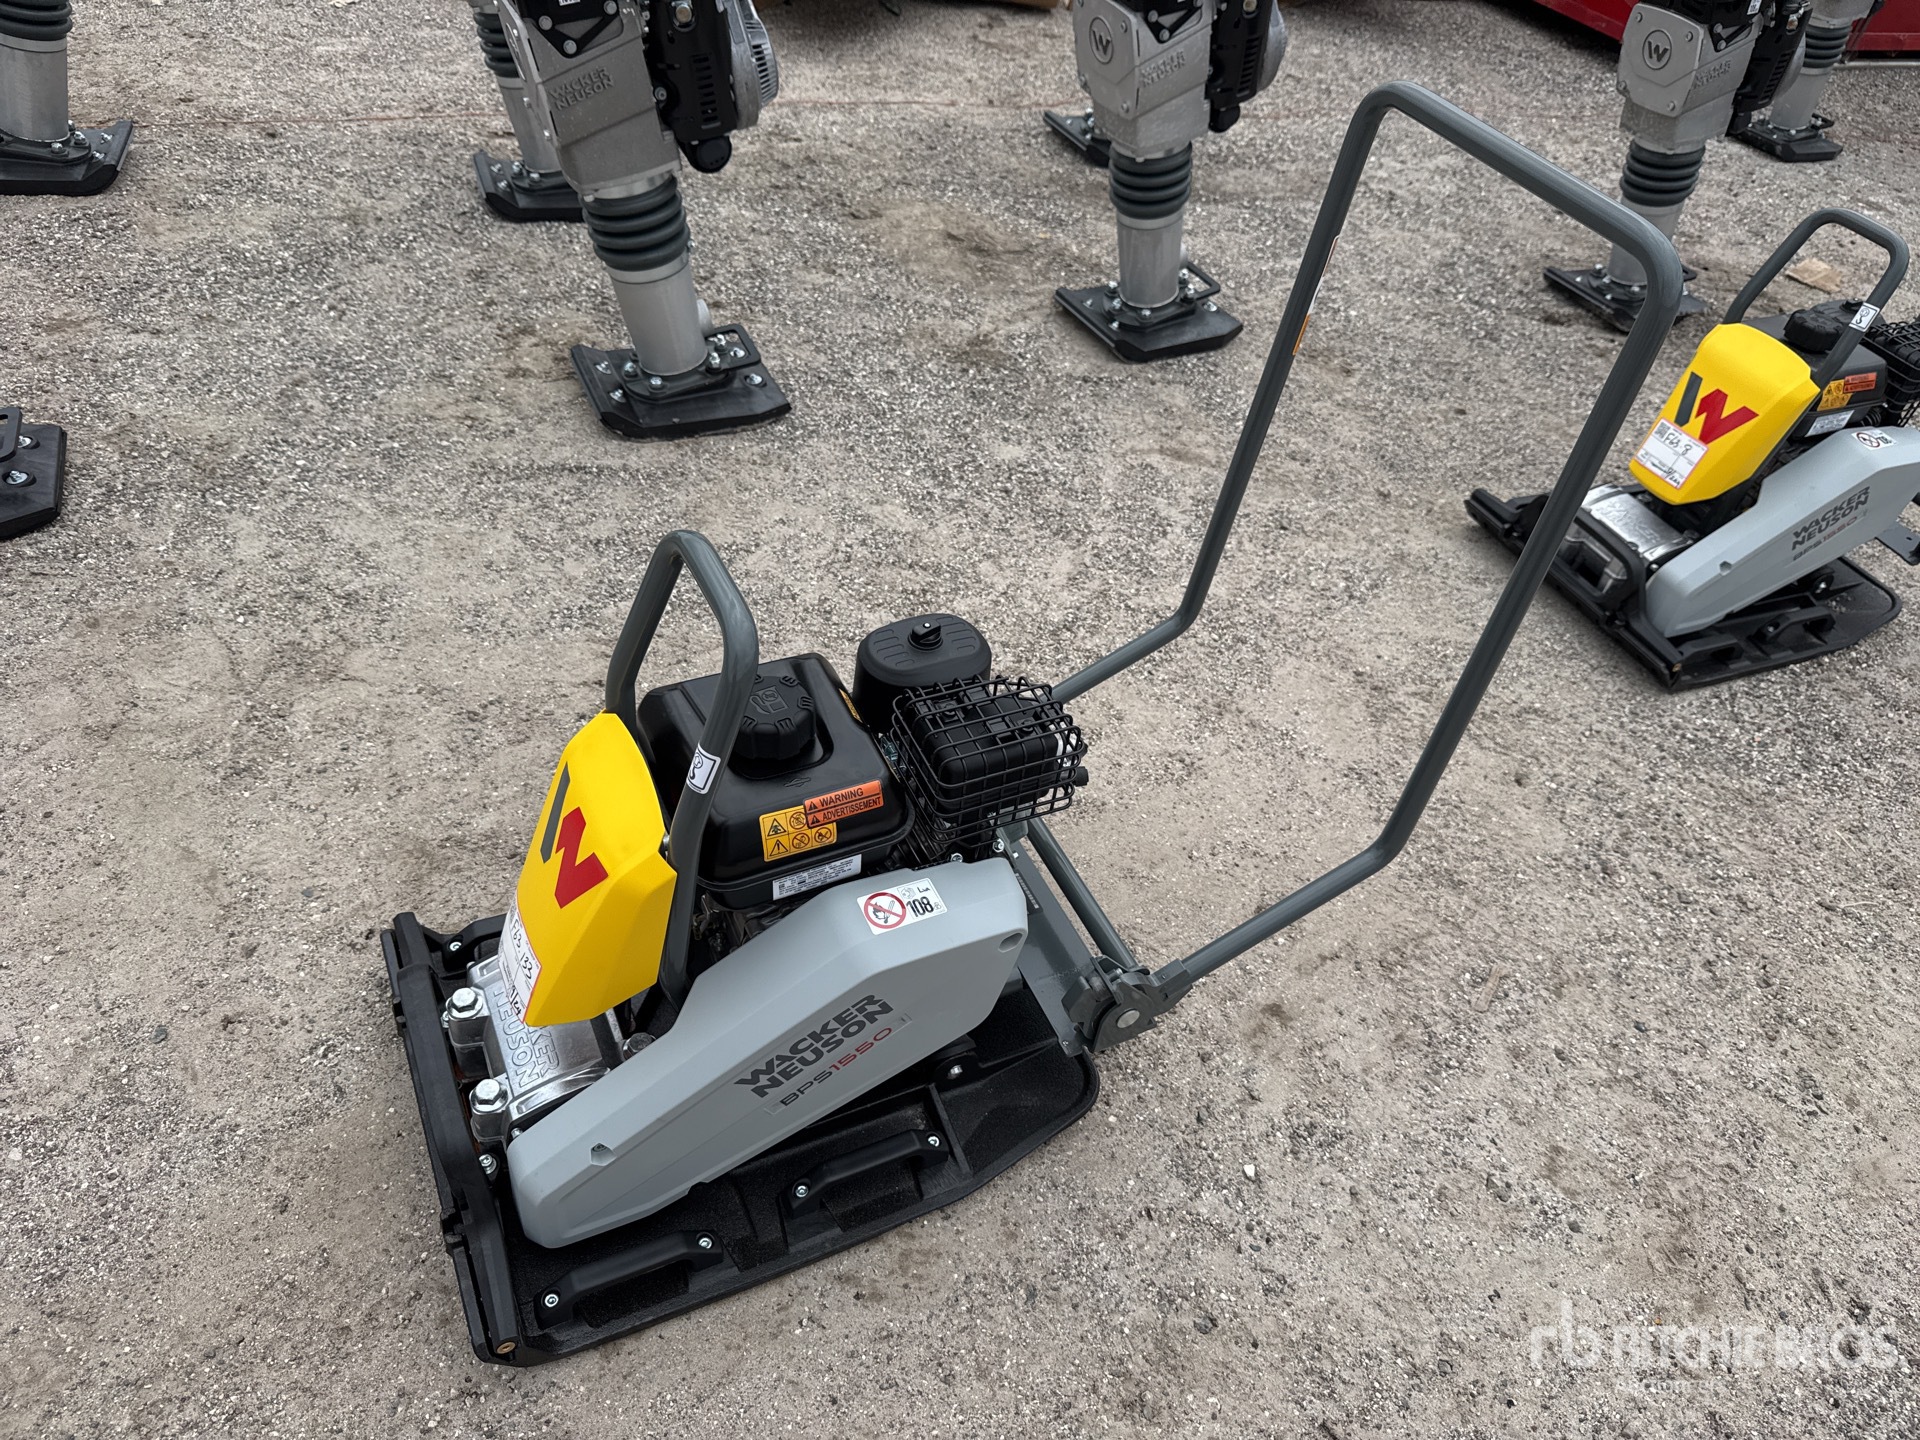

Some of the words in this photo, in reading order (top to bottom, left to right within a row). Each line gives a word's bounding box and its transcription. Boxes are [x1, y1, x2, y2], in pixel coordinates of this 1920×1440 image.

[549, 67, 610, 99] WACKER
[555, 74, 614, 110] NEUSON
[1792, 495, 1869, 551] NEUSON
[1793, 486, 1870, 538] WACKER
[819, 788, 864, 808] WARNING
[822, 797, 881, 821] ADVERTISSEMENT
[906, 896, 934, 918] 108
[493, 990, 540, 1088] NEUSON
[733, 995, 884, 1085] WACKER
[751, 1001, 894, 1098] NEUSON
[780, 1027, 892, 1106] BPS1550
